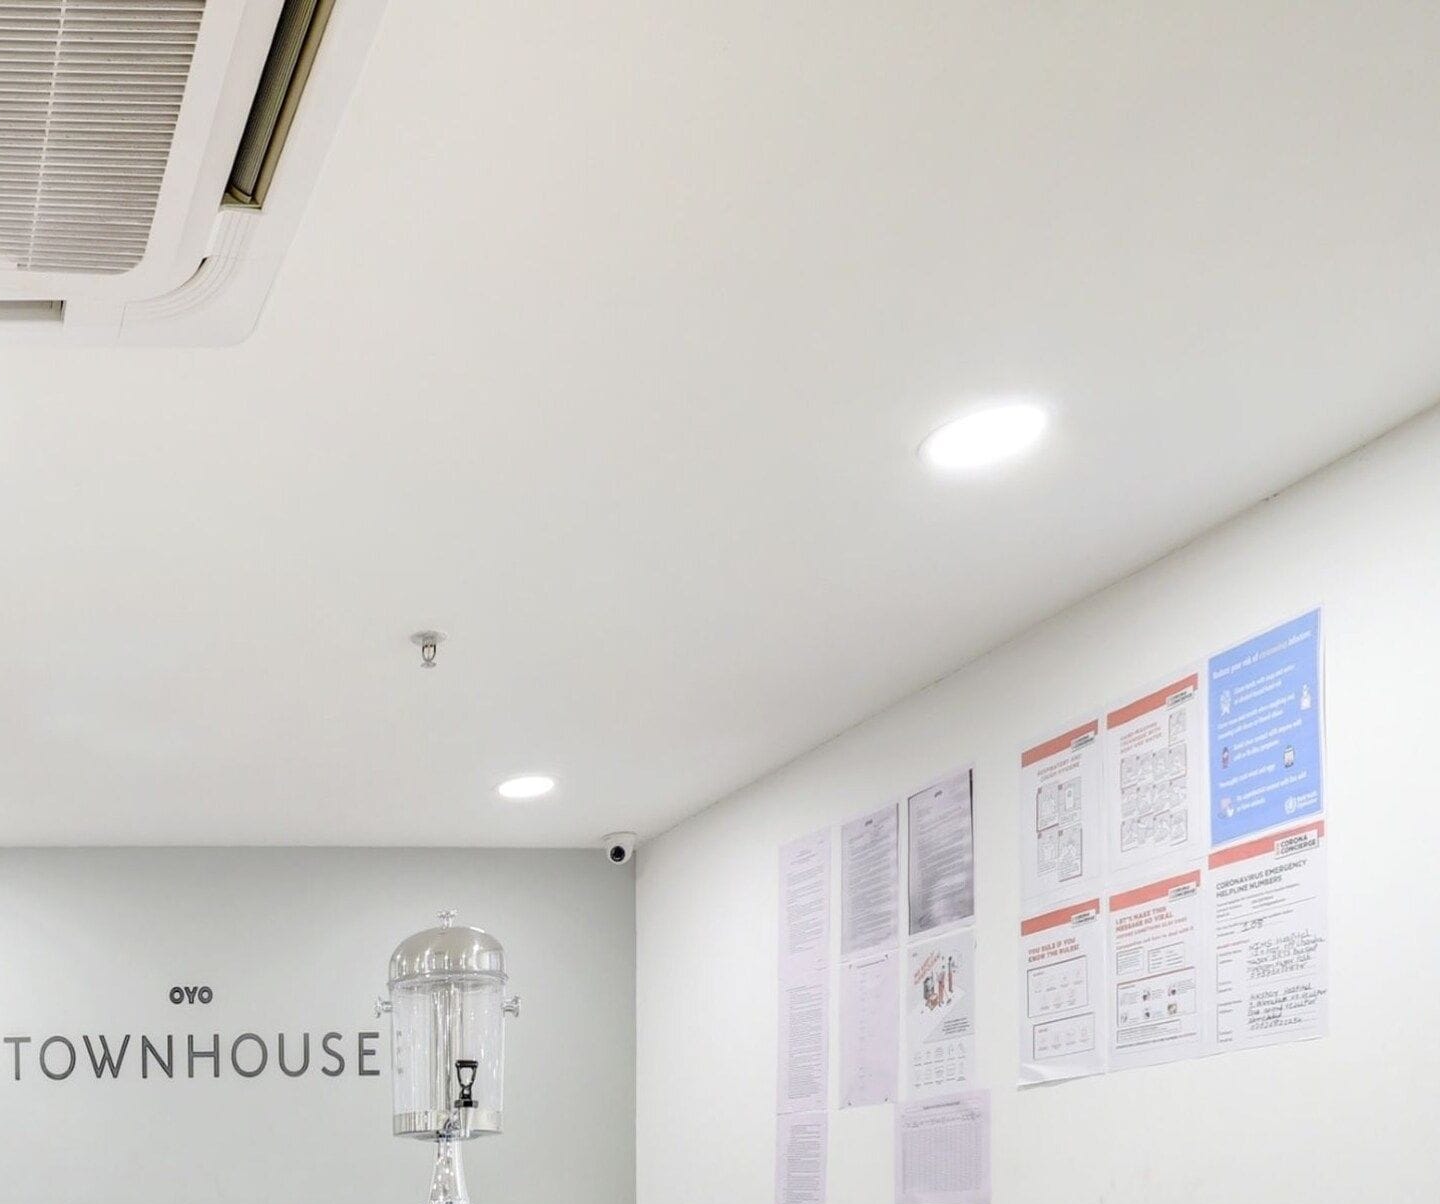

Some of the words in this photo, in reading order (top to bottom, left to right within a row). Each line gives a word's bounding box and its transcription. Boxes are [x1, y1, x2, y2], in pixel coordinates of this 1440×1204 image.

[1216, 870, 1264, 890] CORONAVIRUS
[169, 986, 213, 1004] OYO
[3, 1032, 380, 1081] TOWNHOUSE
